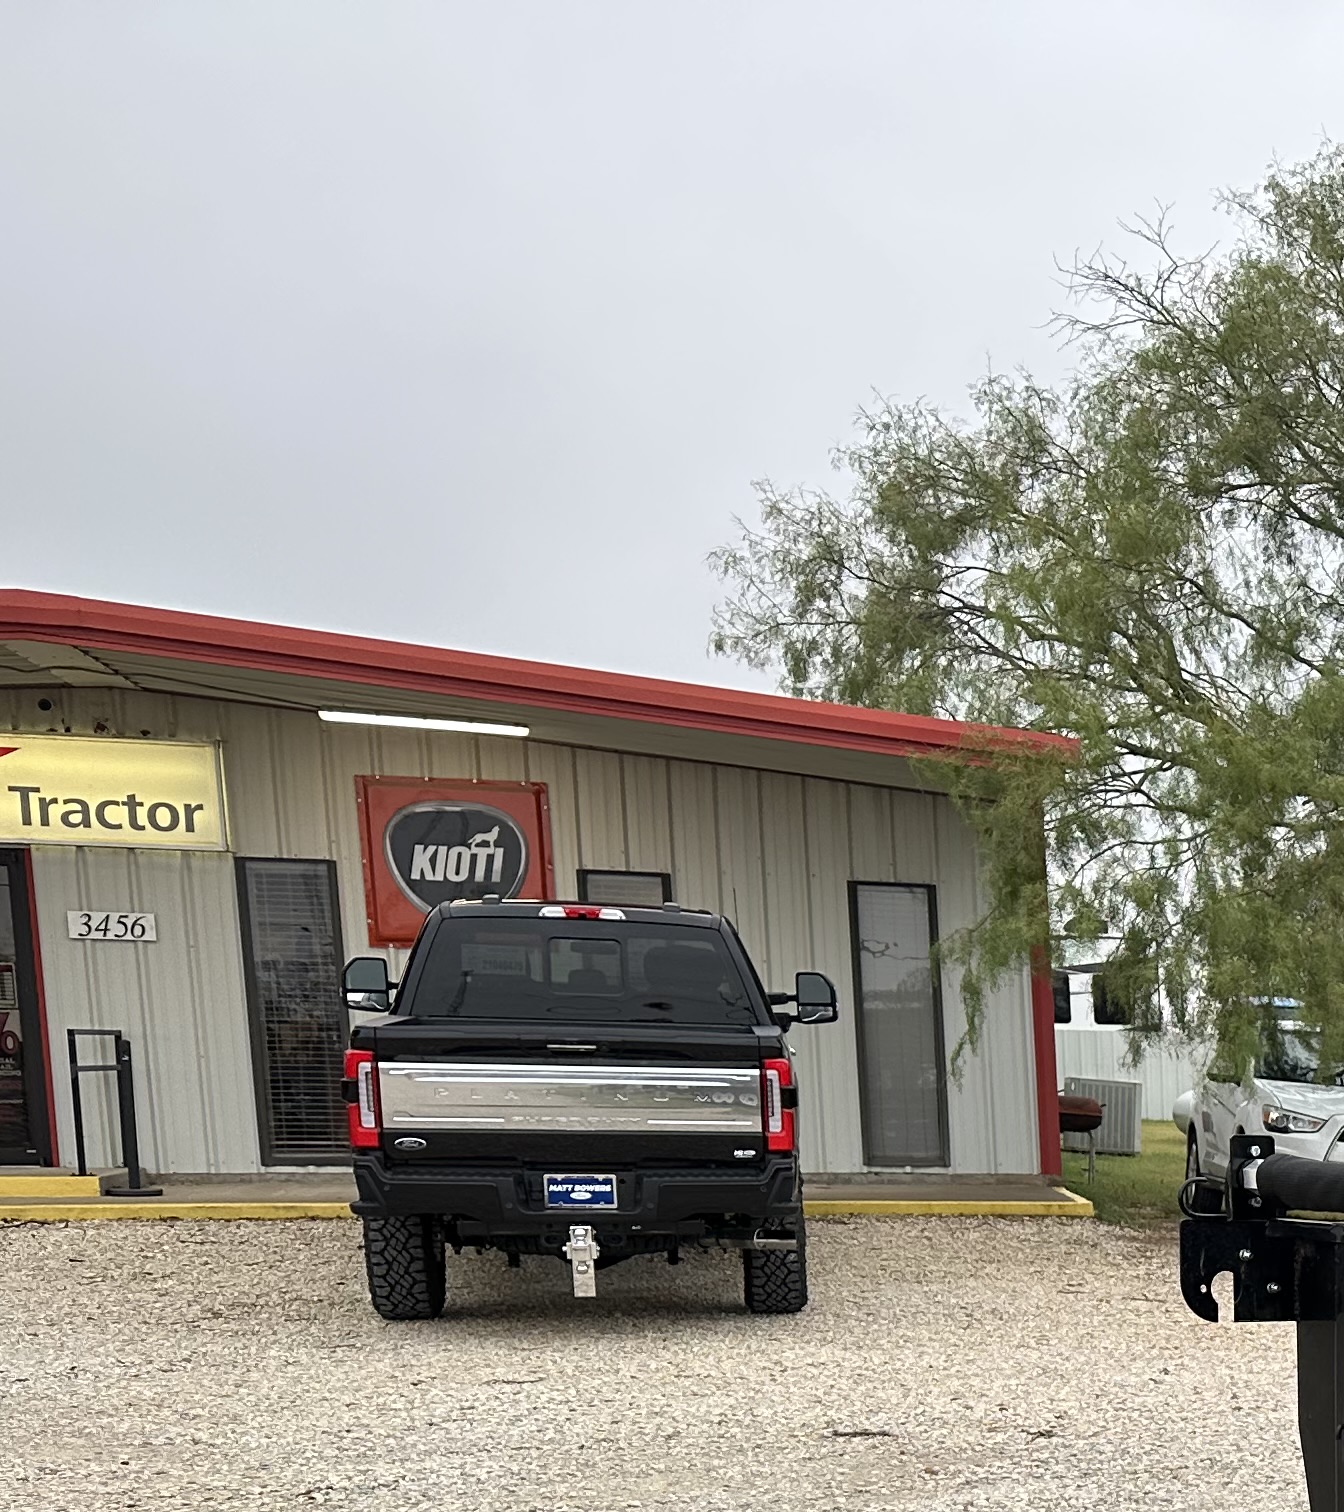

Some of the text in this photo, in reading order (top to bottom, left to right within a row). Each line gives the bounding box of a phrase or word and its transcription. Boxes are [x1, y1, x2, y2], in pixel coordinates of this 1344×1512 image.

[8, 786, 204, 833] Tractor
[410, 844, 504, 883] KIOTI
[78, 913, 146, 938] 3456
